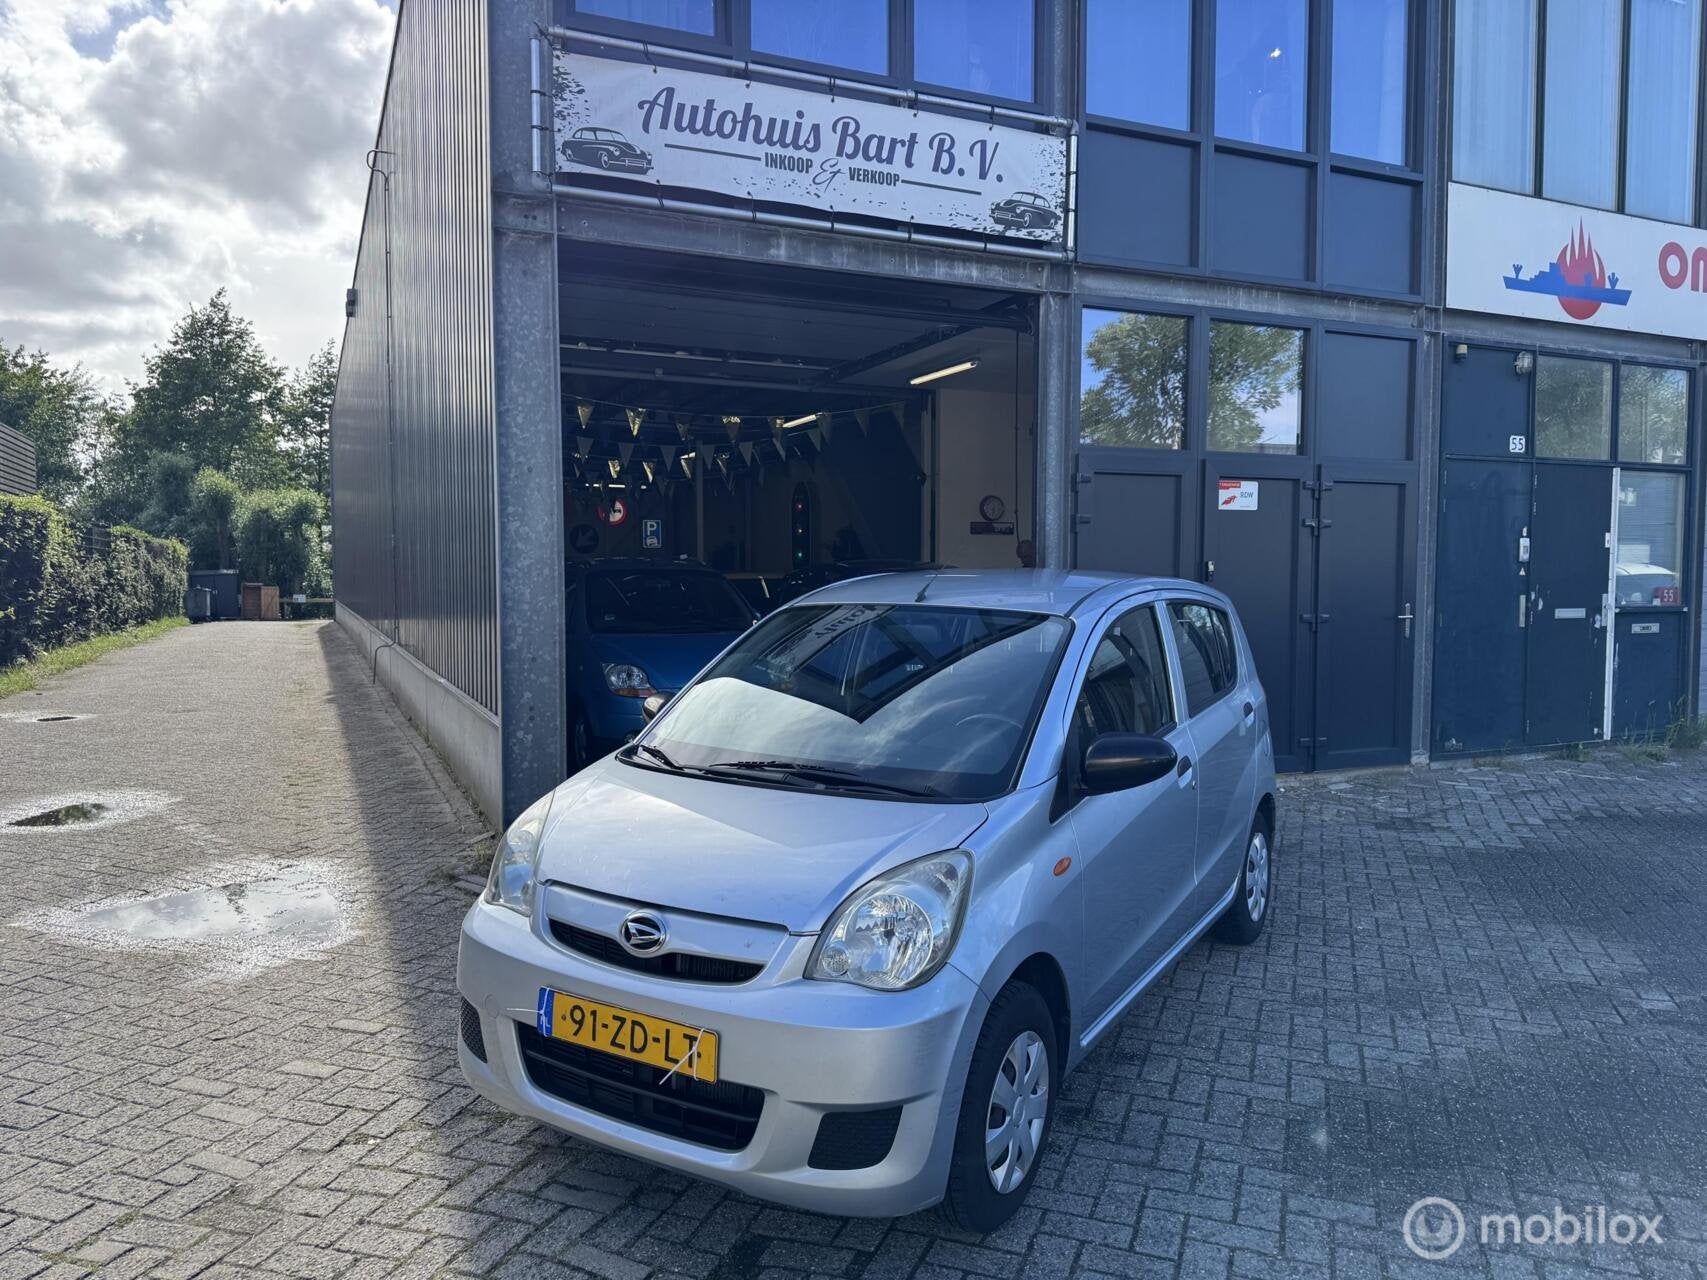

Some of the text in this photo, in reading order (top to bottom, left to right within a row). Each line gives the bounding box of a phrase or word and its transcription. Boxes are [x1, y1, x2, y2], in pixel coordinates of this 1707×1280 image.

[638, 87, 1003, 182] Autohuis Bart B.V.
[764, 152, 813, 174] INKOOP
[848, 166, 900, 187] VERKOOP
[1511, 437, 1524, 451] 55
[646, 521, 657, 536] P
[1664, 589, 1674, 602] 55
[569, 1004, 699, 1068] 91-ZD-LT
